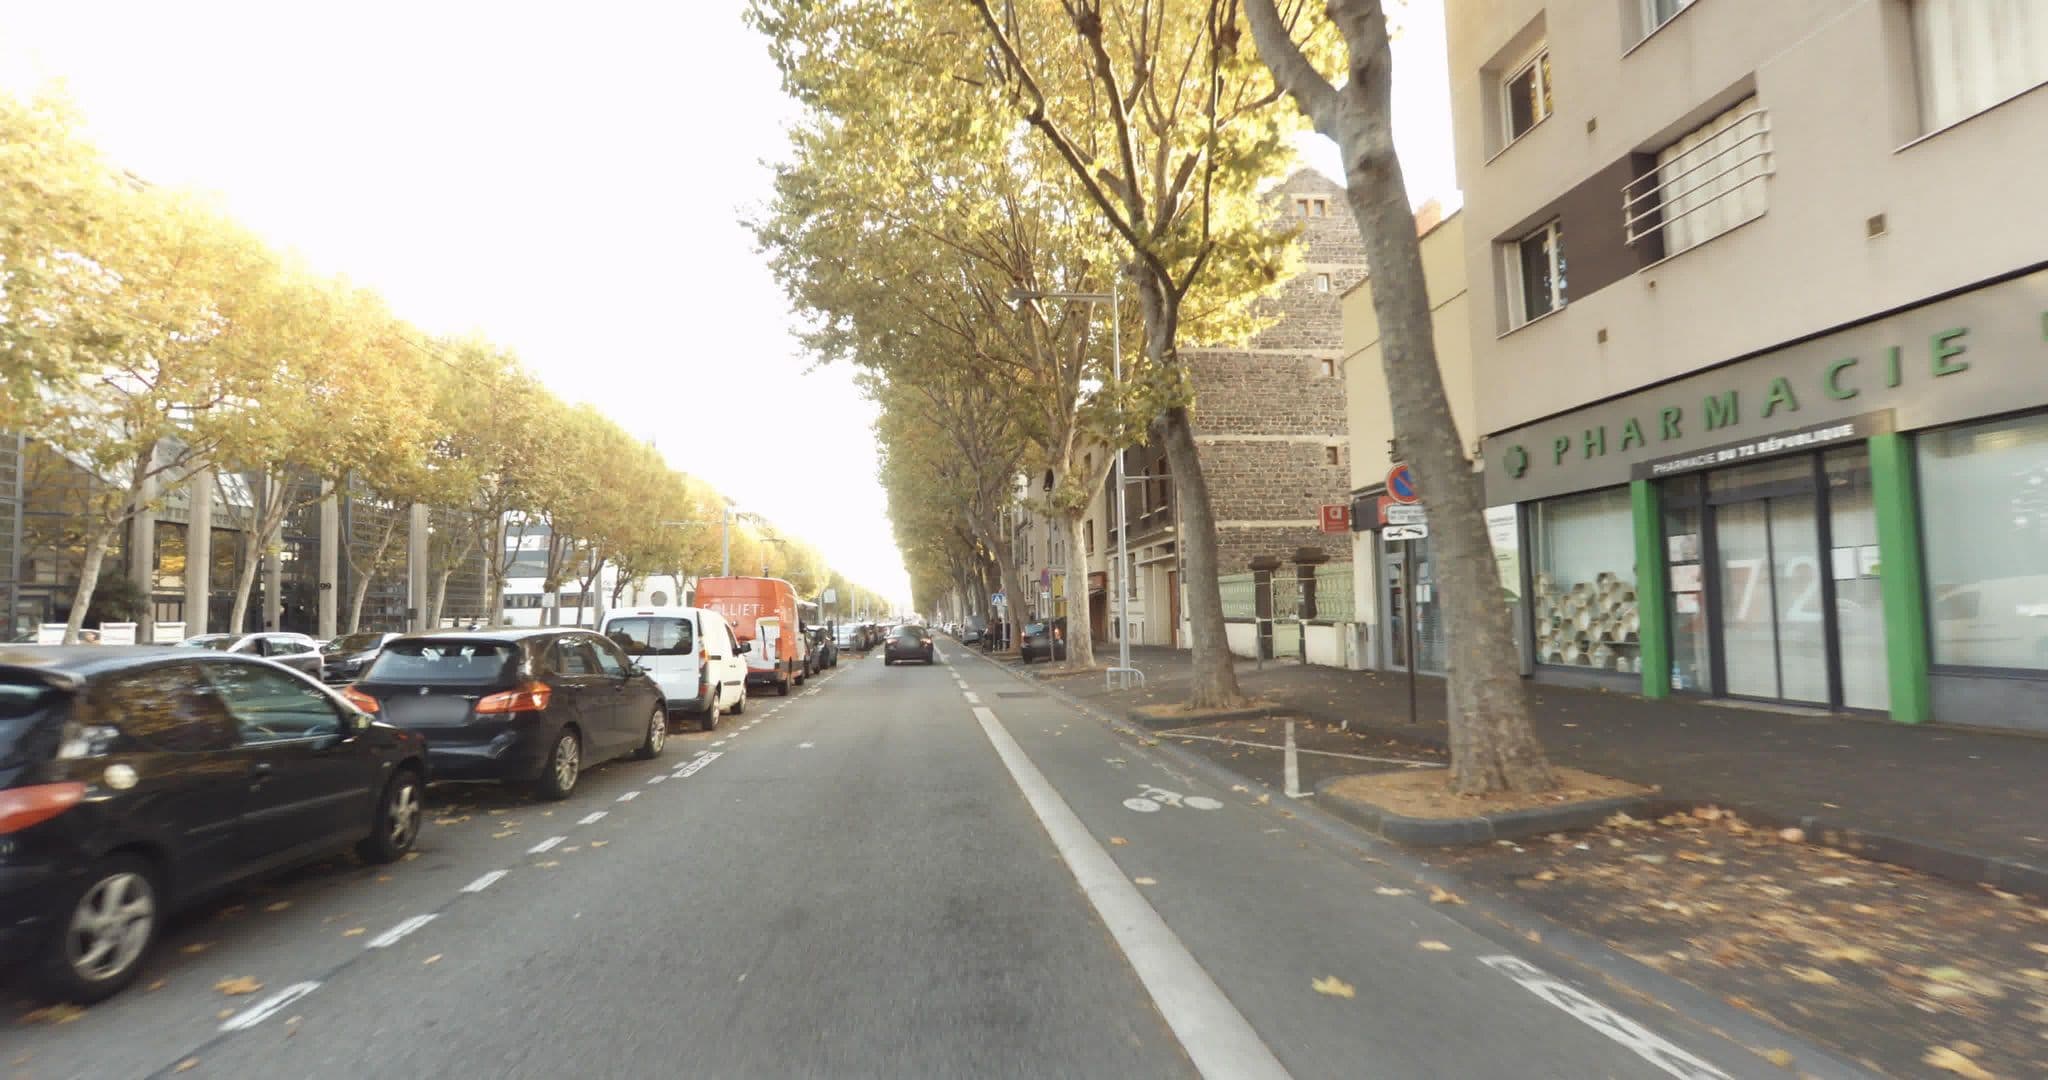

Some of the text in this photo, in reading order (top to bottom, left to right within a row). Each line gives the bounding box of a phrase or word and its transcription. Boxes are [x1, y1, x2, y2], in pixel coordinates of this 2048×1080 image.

[1552, 327, 1970, 465] PHARMACIE
[1652, 424, 1855, 475] PHARMACIE DU 72 RÉPUBLIQUE
